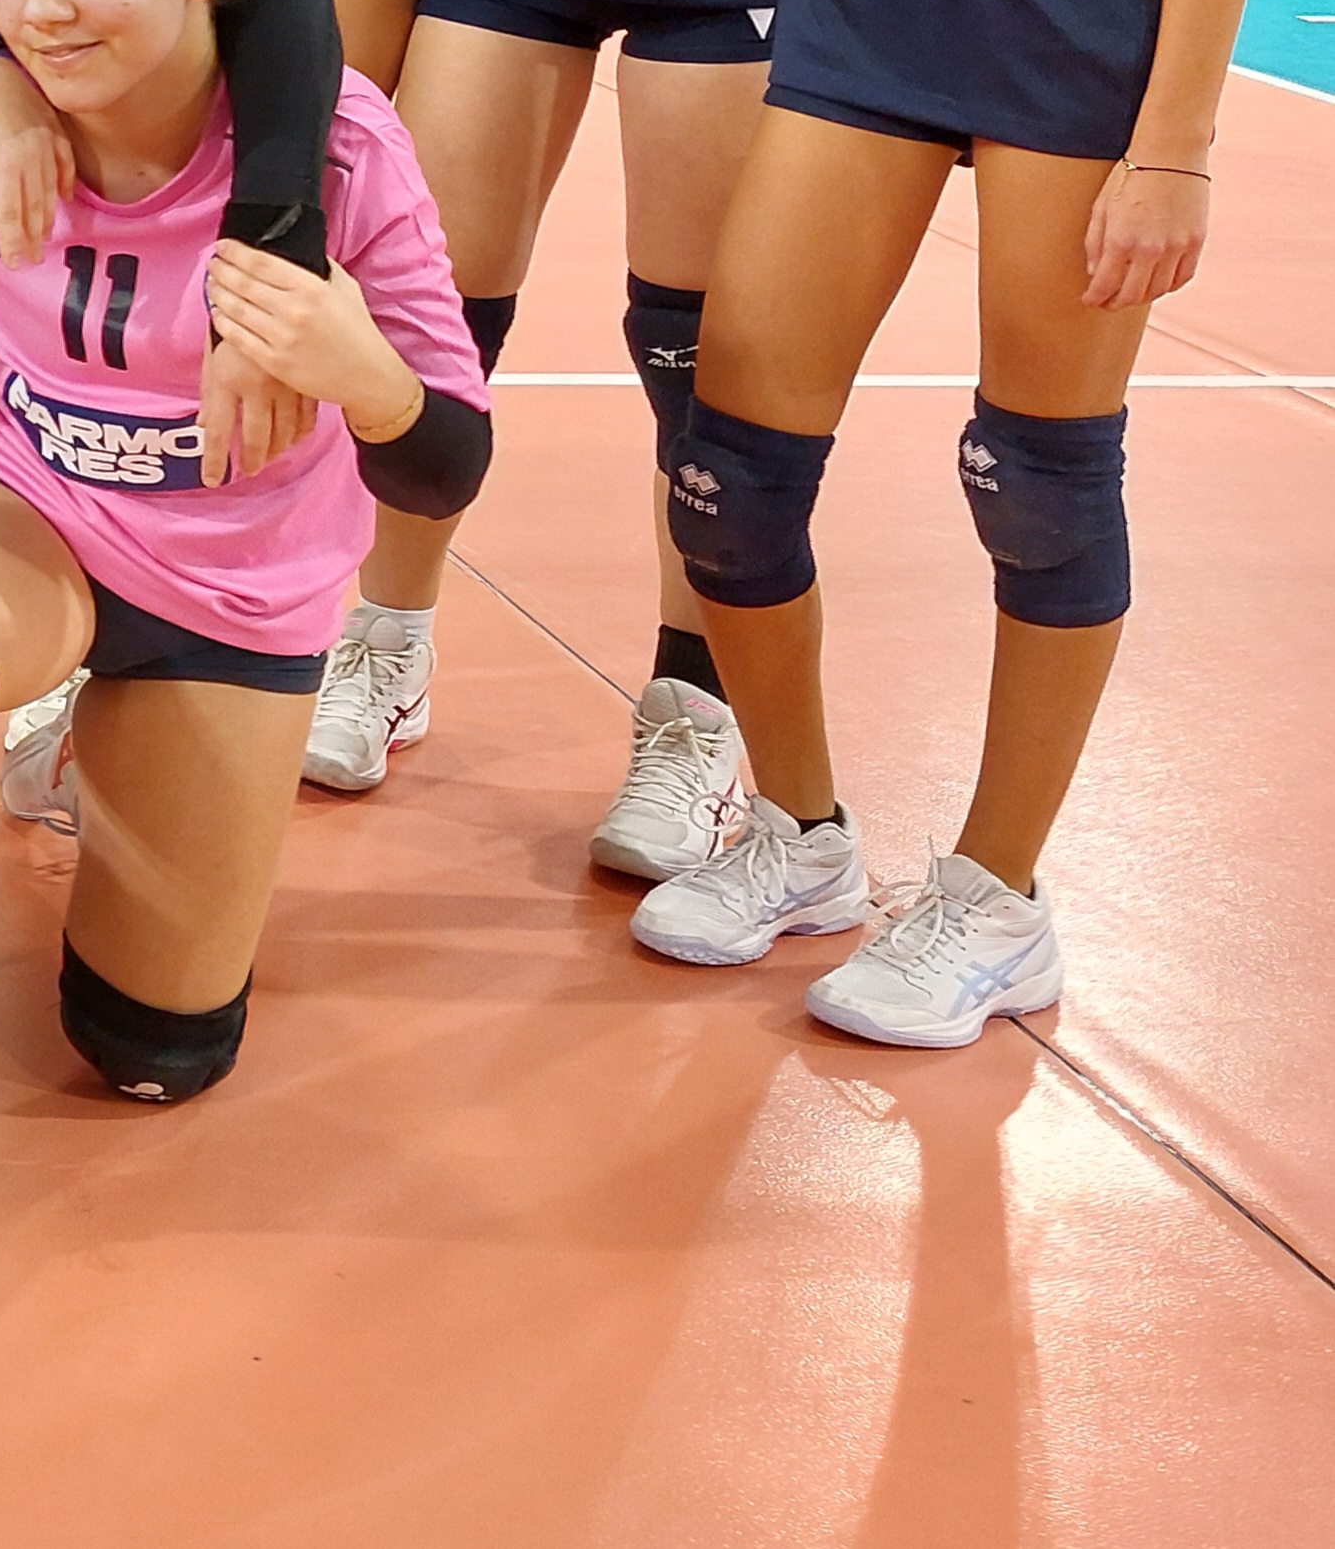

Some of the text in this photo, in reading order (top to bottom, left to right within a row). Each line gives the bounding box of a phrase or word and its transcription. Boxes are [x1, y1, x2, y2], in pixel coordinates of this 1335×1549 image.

[61, 245, 139, 370] 11
[7, 372, 206, 457] FARMO
[40, 432, 165, 484] RES
